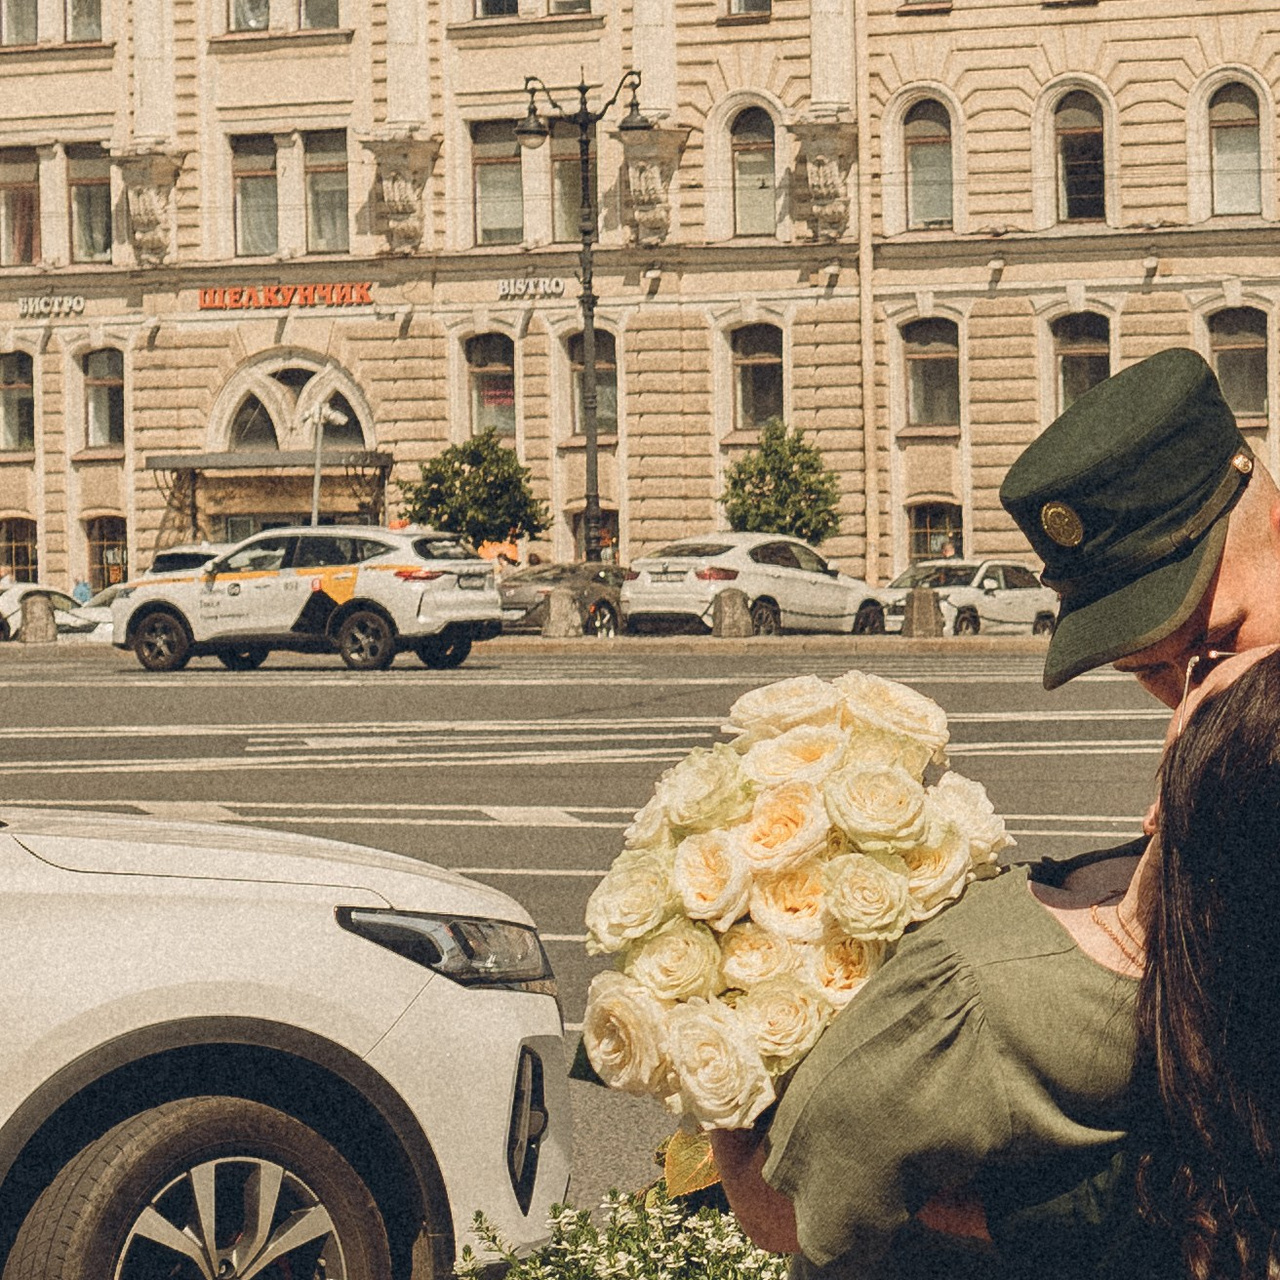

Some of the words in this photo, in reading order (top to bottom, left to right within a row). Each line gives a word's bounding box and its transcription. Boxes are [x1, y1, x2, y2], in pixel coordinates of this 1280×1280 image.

[199, 282, 373, 310] ЩЕЛКУНЧИК
[499, 278, 565, 296] BISTRO
[18, 295, 85, 314] БИСТРО
